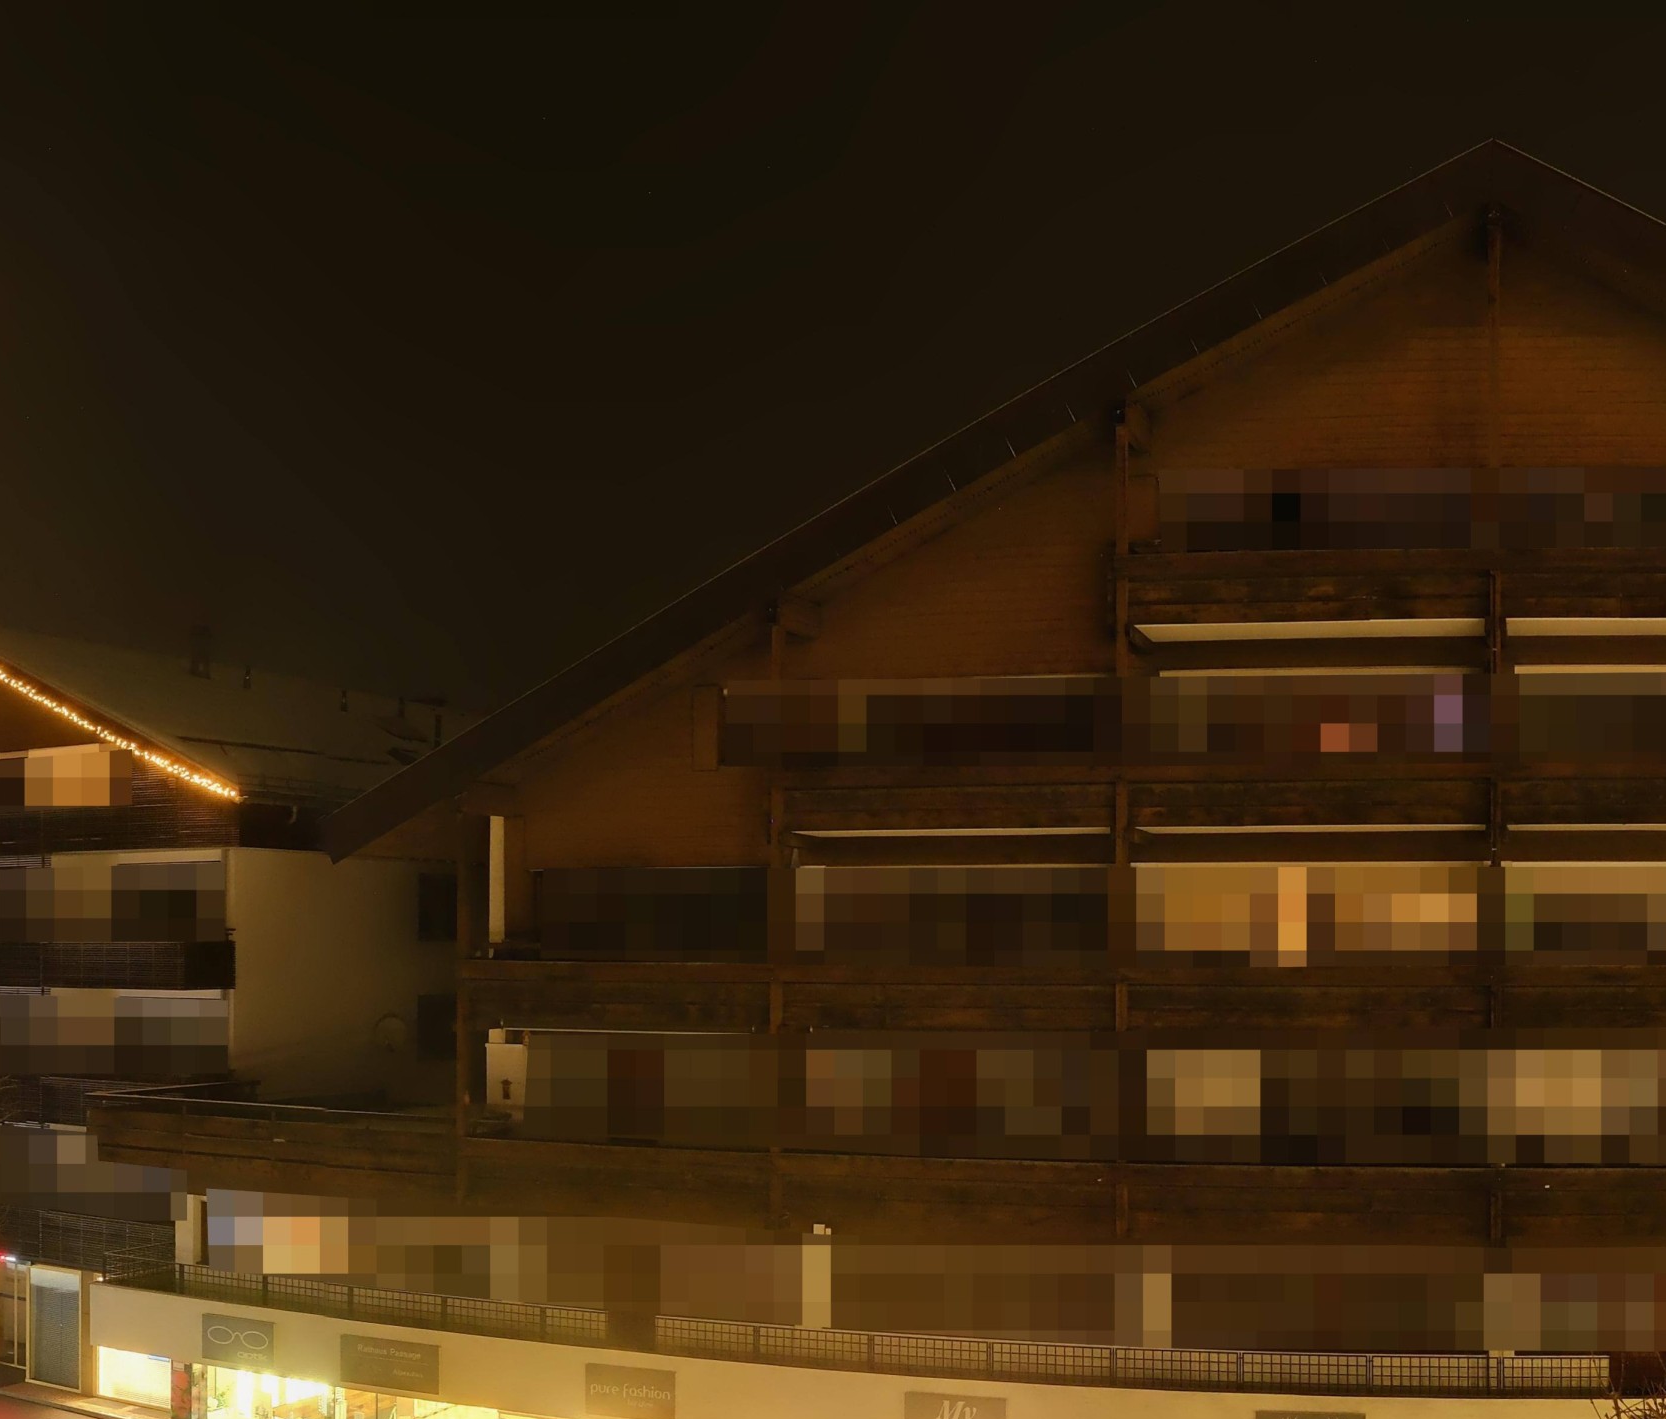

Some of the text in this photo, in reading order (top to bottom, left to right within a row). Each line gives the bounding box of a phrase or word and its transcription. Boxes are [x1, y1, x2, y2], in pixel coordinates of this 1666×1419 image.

[390, 1348, 421, 1360] Passage
[590, 1383, 671, 1400] pure fashion
